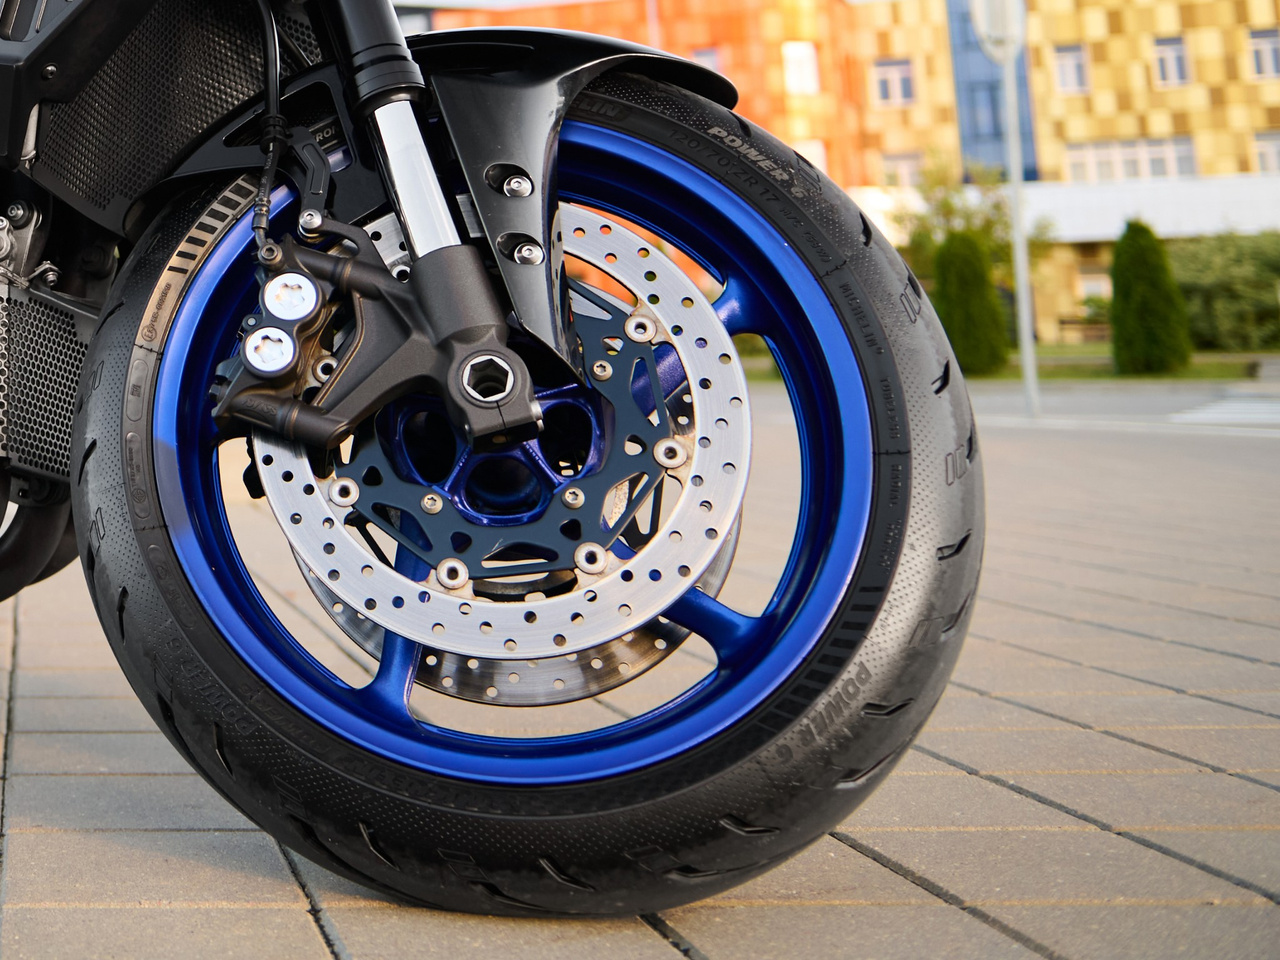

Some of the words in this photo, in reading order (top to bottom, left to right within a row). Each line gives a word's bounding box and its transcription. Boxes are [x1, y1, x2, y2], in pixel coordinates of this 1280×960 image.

[572, 99, 621, 117] LIN
[670, 129, 732, 168] 120/70
[733, 166, 759, 188] ZR
[758, 185, 781, 203] 17
[706, 125, 790, 182] POWER
[789, 185, 809, 200] 6
[838, 281, 879, 349] MICHELIN
[165, 637, 184, 655] 6
[181, 660, 258, 737] POWER
[798, 660, 872, 747] POWER
[775, 743, 795, 764] 6
